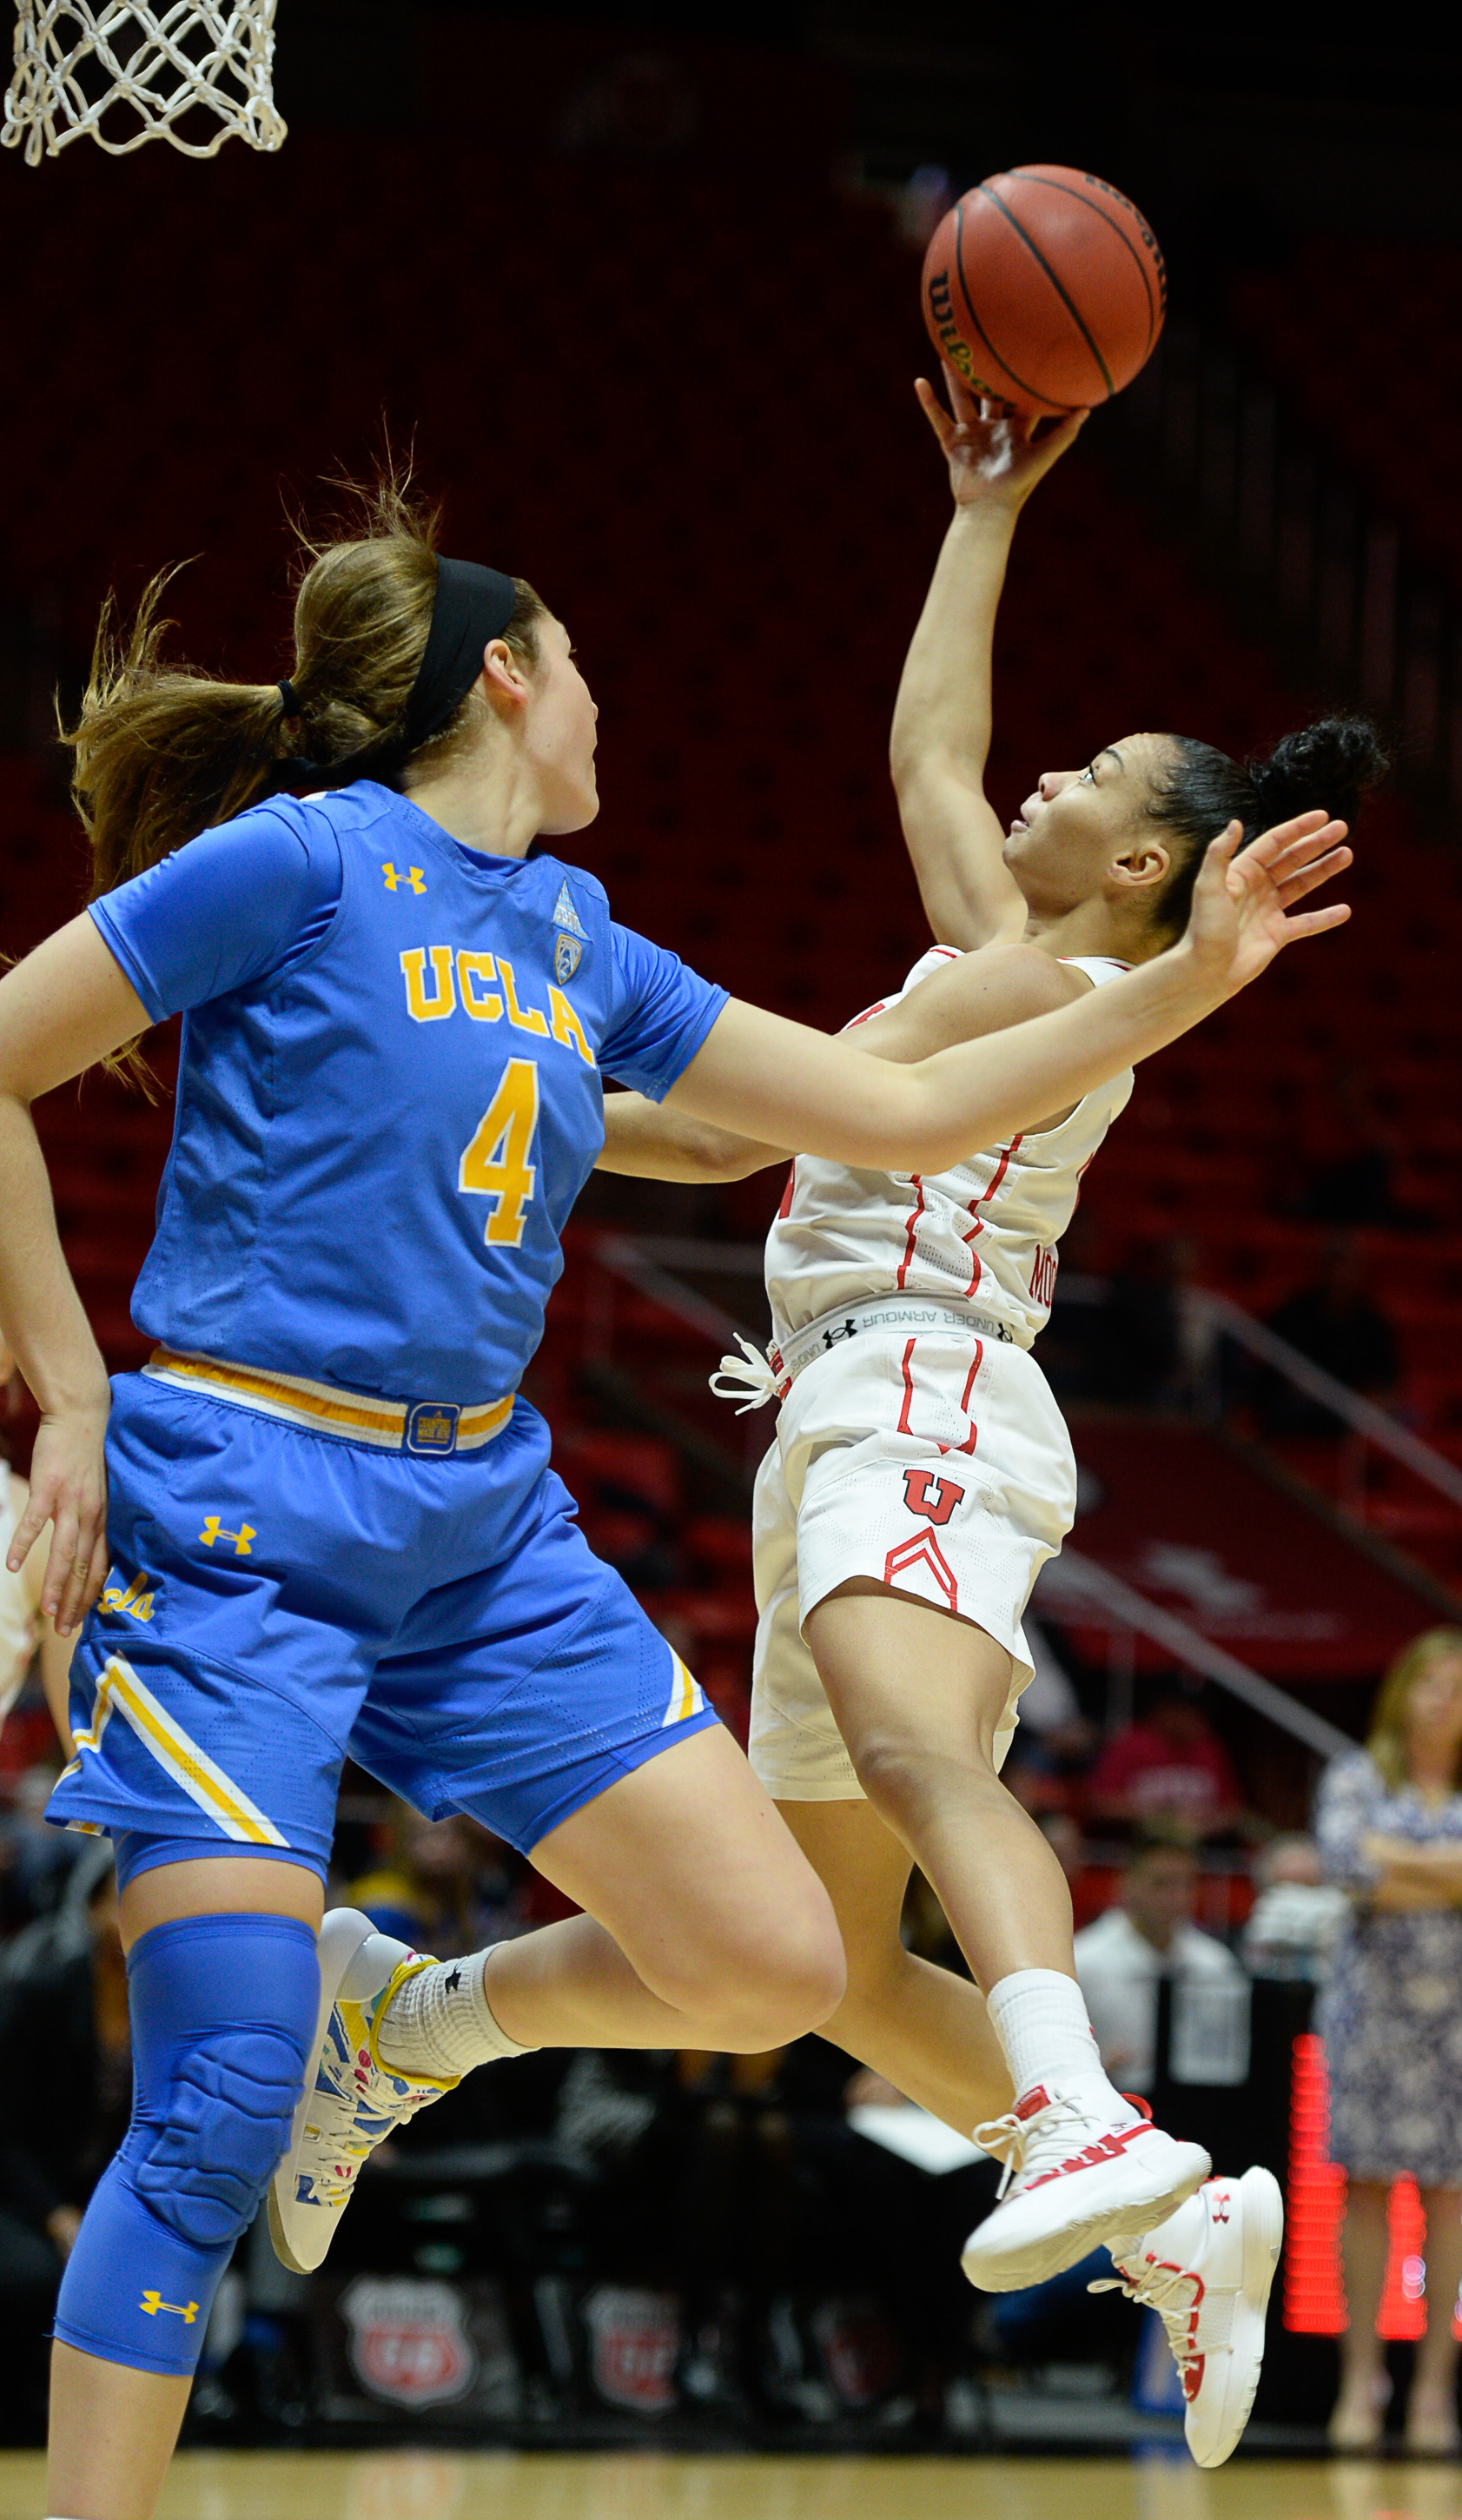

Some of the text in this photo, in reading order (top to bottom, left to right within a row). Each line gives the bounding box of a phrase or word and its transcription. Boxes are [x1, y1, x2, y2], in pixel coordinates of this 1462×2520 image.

[400, 945, 597, 1069] UCLA
[459, 1057, 539, 1248] 4
[863, 1310, 995, 1333] UNDER ARMOUR
